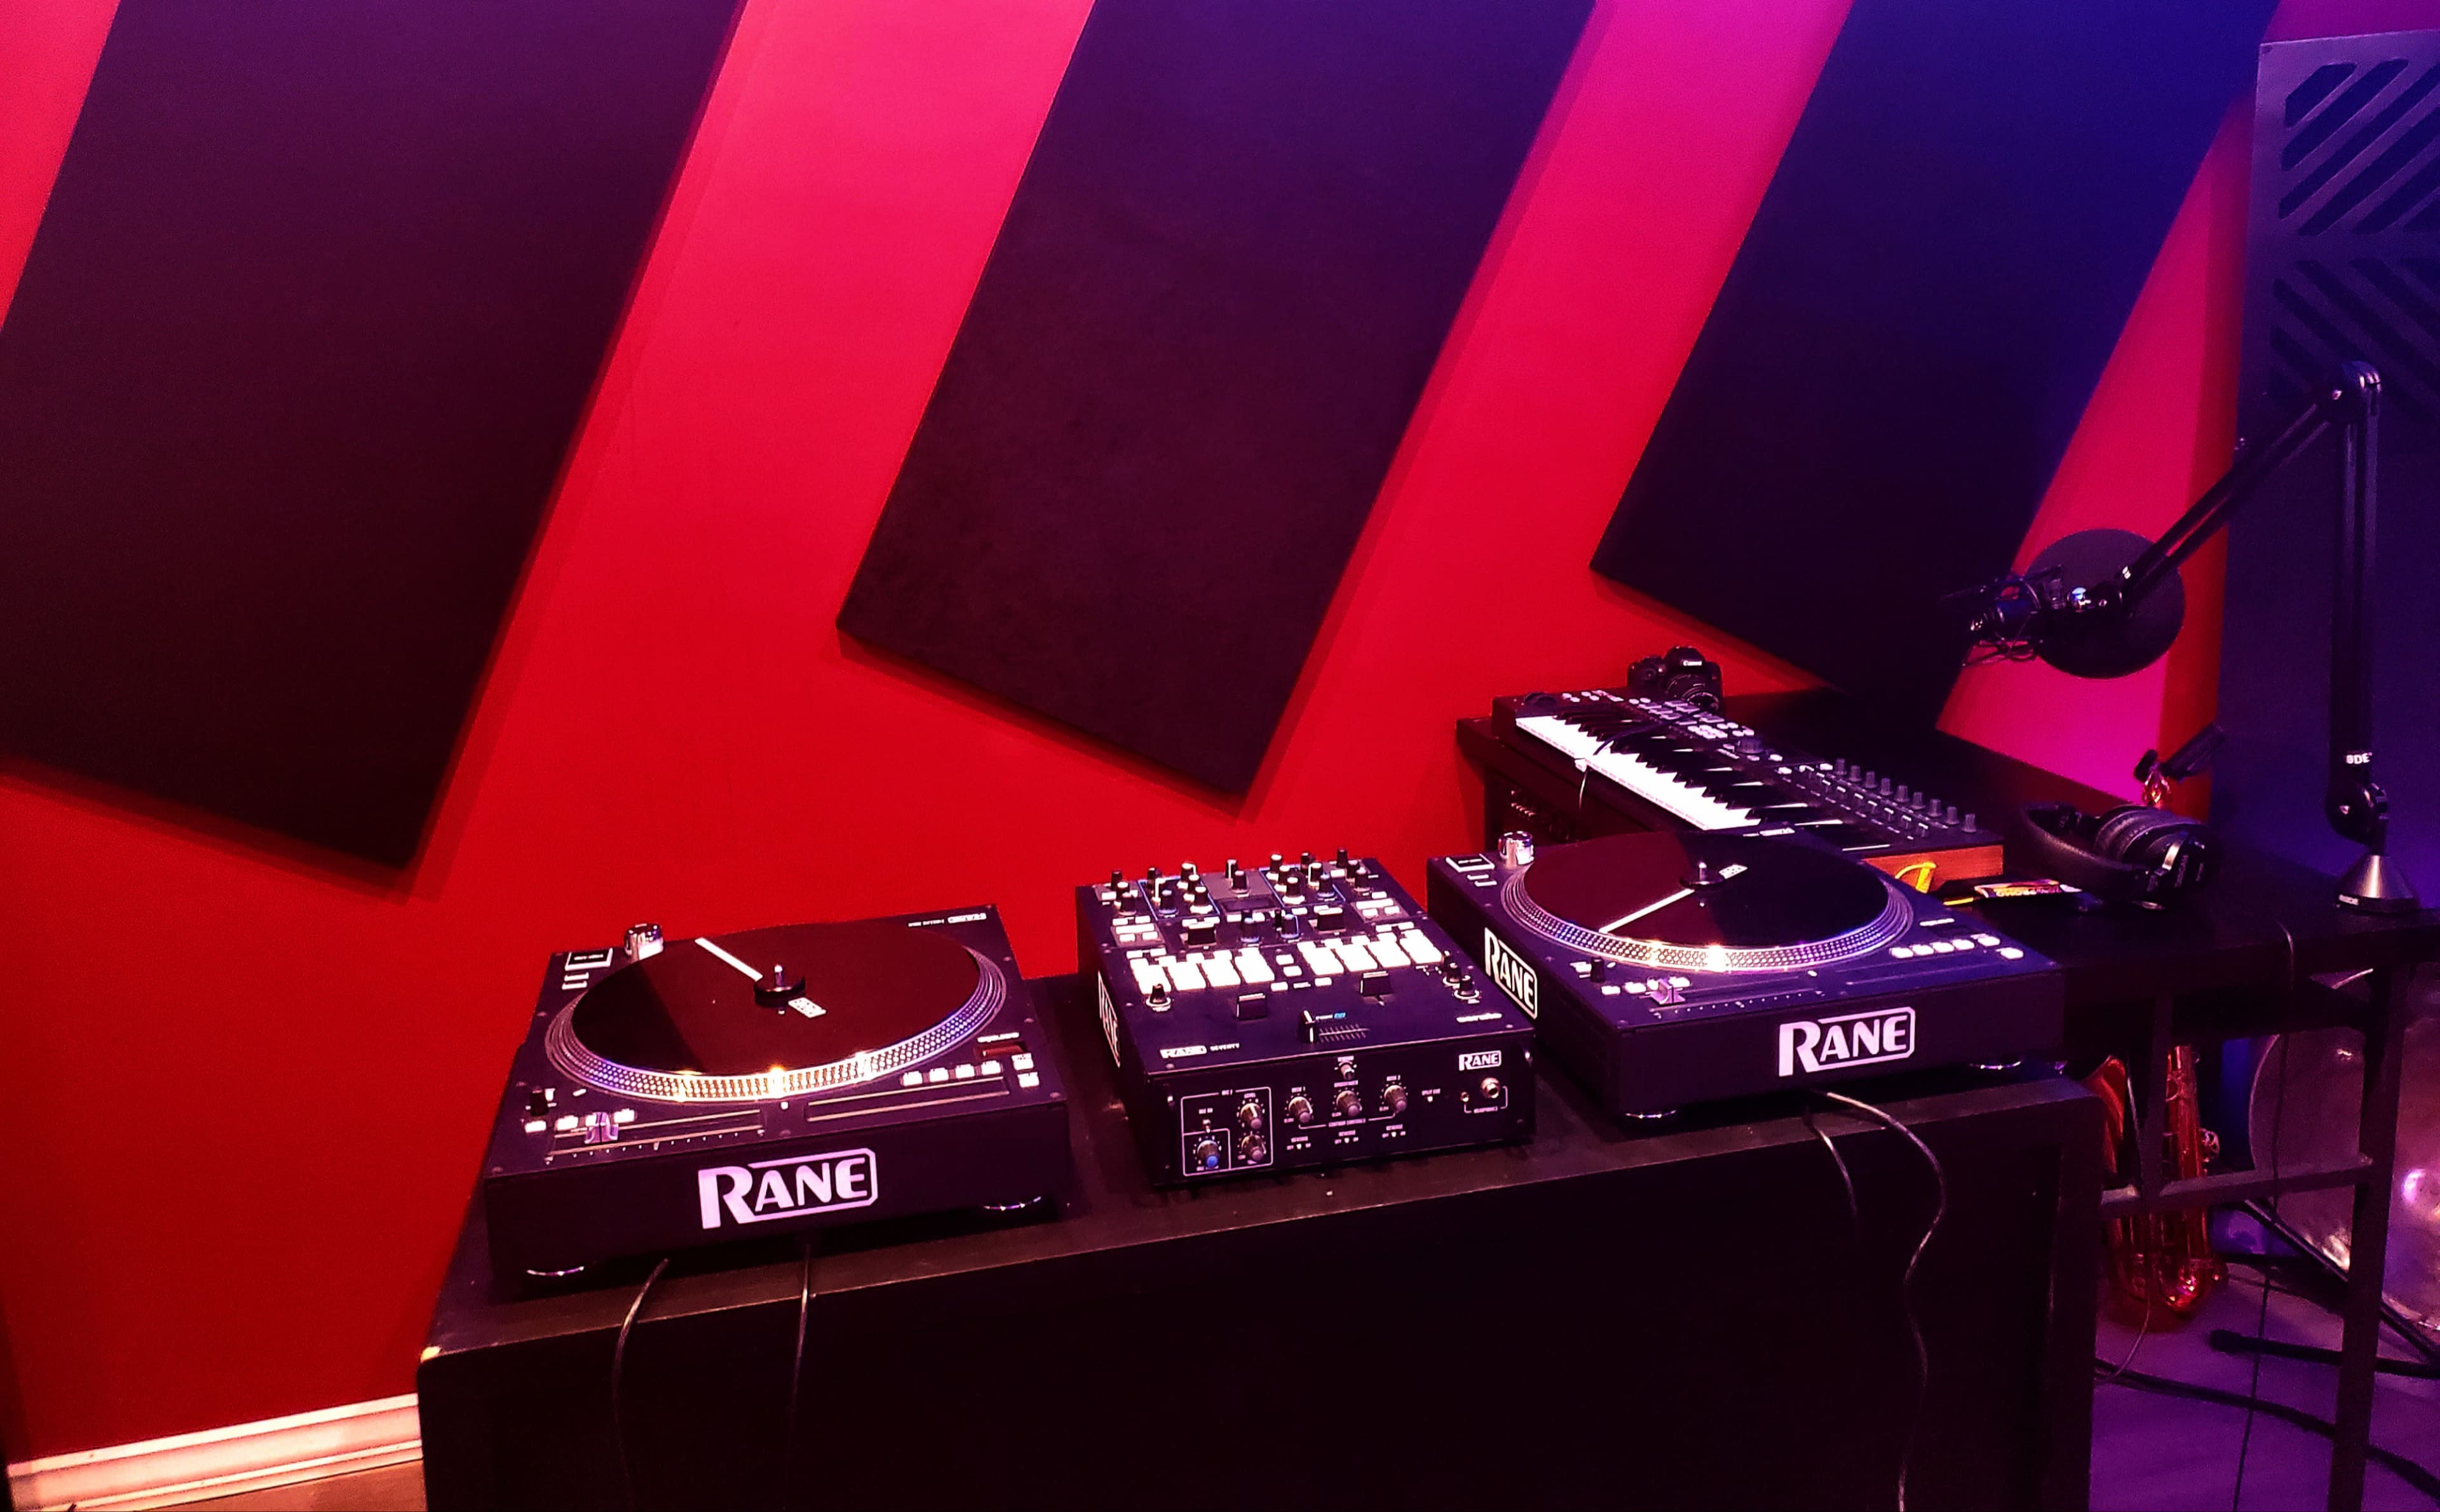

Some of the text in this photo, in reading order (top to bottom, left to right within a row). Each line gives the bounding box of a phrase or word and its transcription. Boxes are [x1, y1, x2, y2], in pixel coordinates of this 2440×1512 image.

[1484, 927, 1535, 1012] RANE
[1098, 970, 1120, 1061] RANE
[1779, 1015, 1908, 1077] RANE
[1459, 1051, 1500, 1071] RANE
[698, 1156, 869, 1229] RANE
